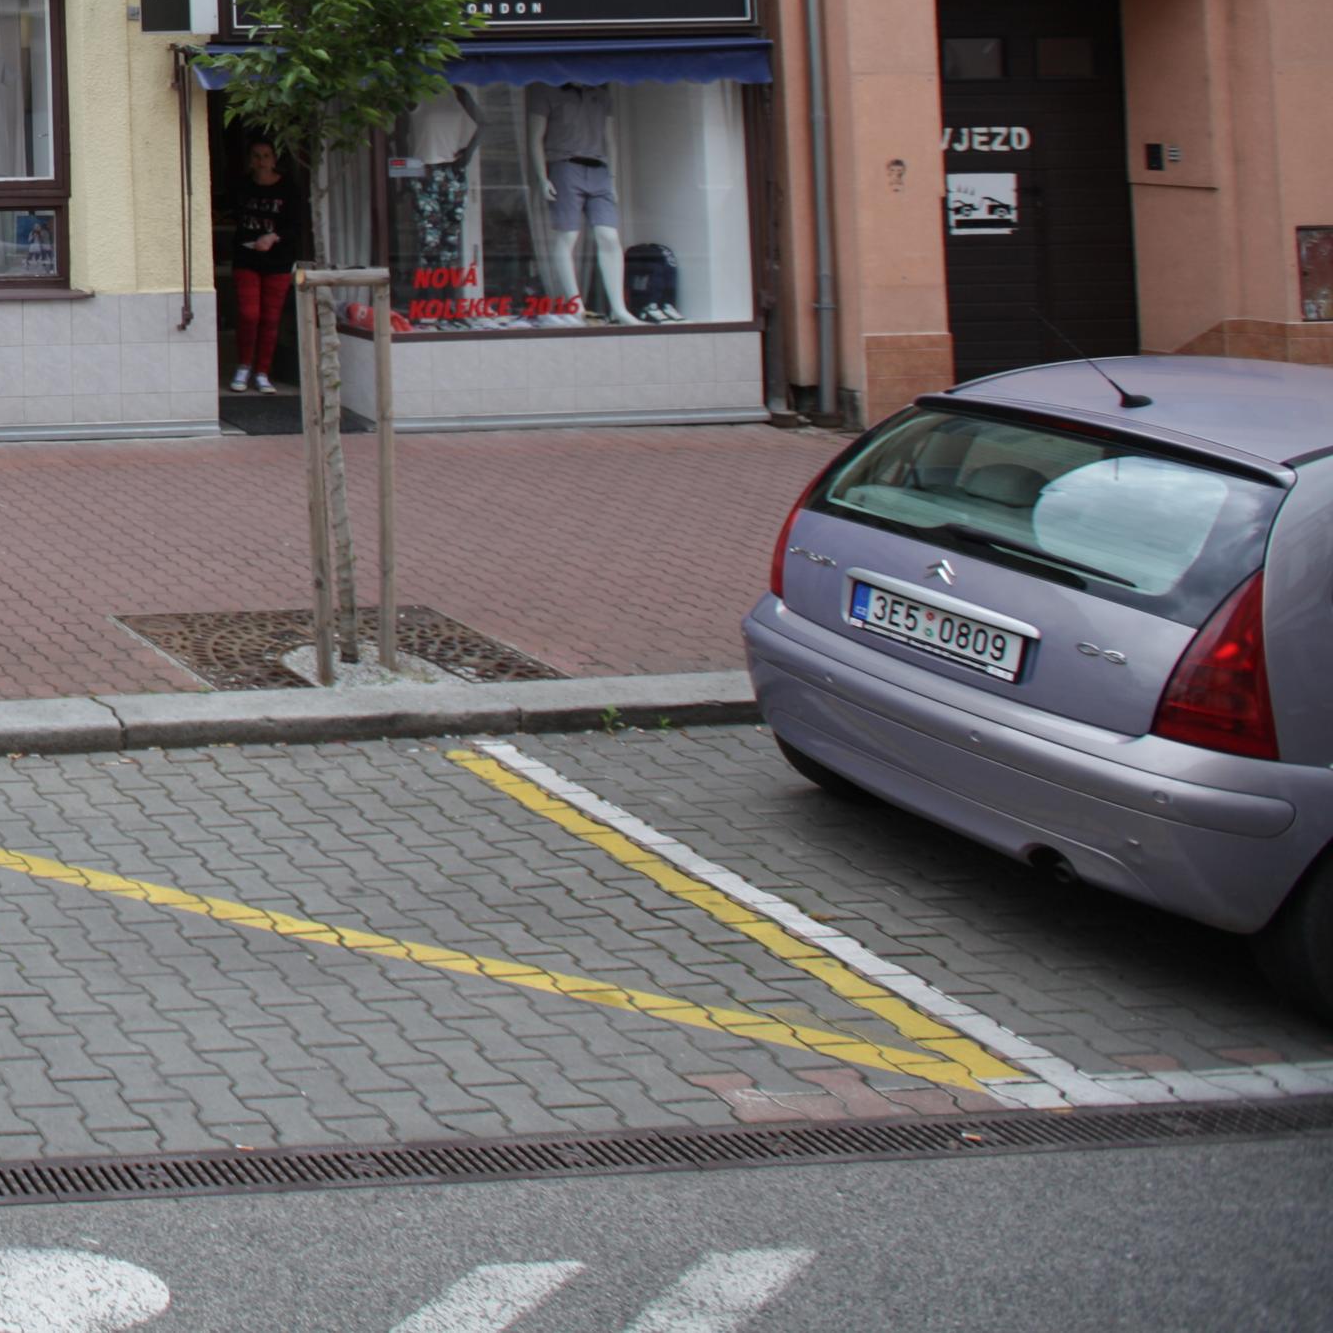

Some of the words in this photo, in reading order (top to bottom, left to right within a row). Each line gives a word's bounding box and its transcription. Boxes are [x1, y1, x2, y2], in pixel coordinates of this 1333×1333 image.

[466, 2, 543, 15] ONDON
[413, 263, 478, 289] NOVÁ
[407, 295, 515, 319] KOLEKCE
[520, 293, 583, 317] 2016
[873, 595, 920, 631] 3E5
[938, 617, 1007, 661] 0809
